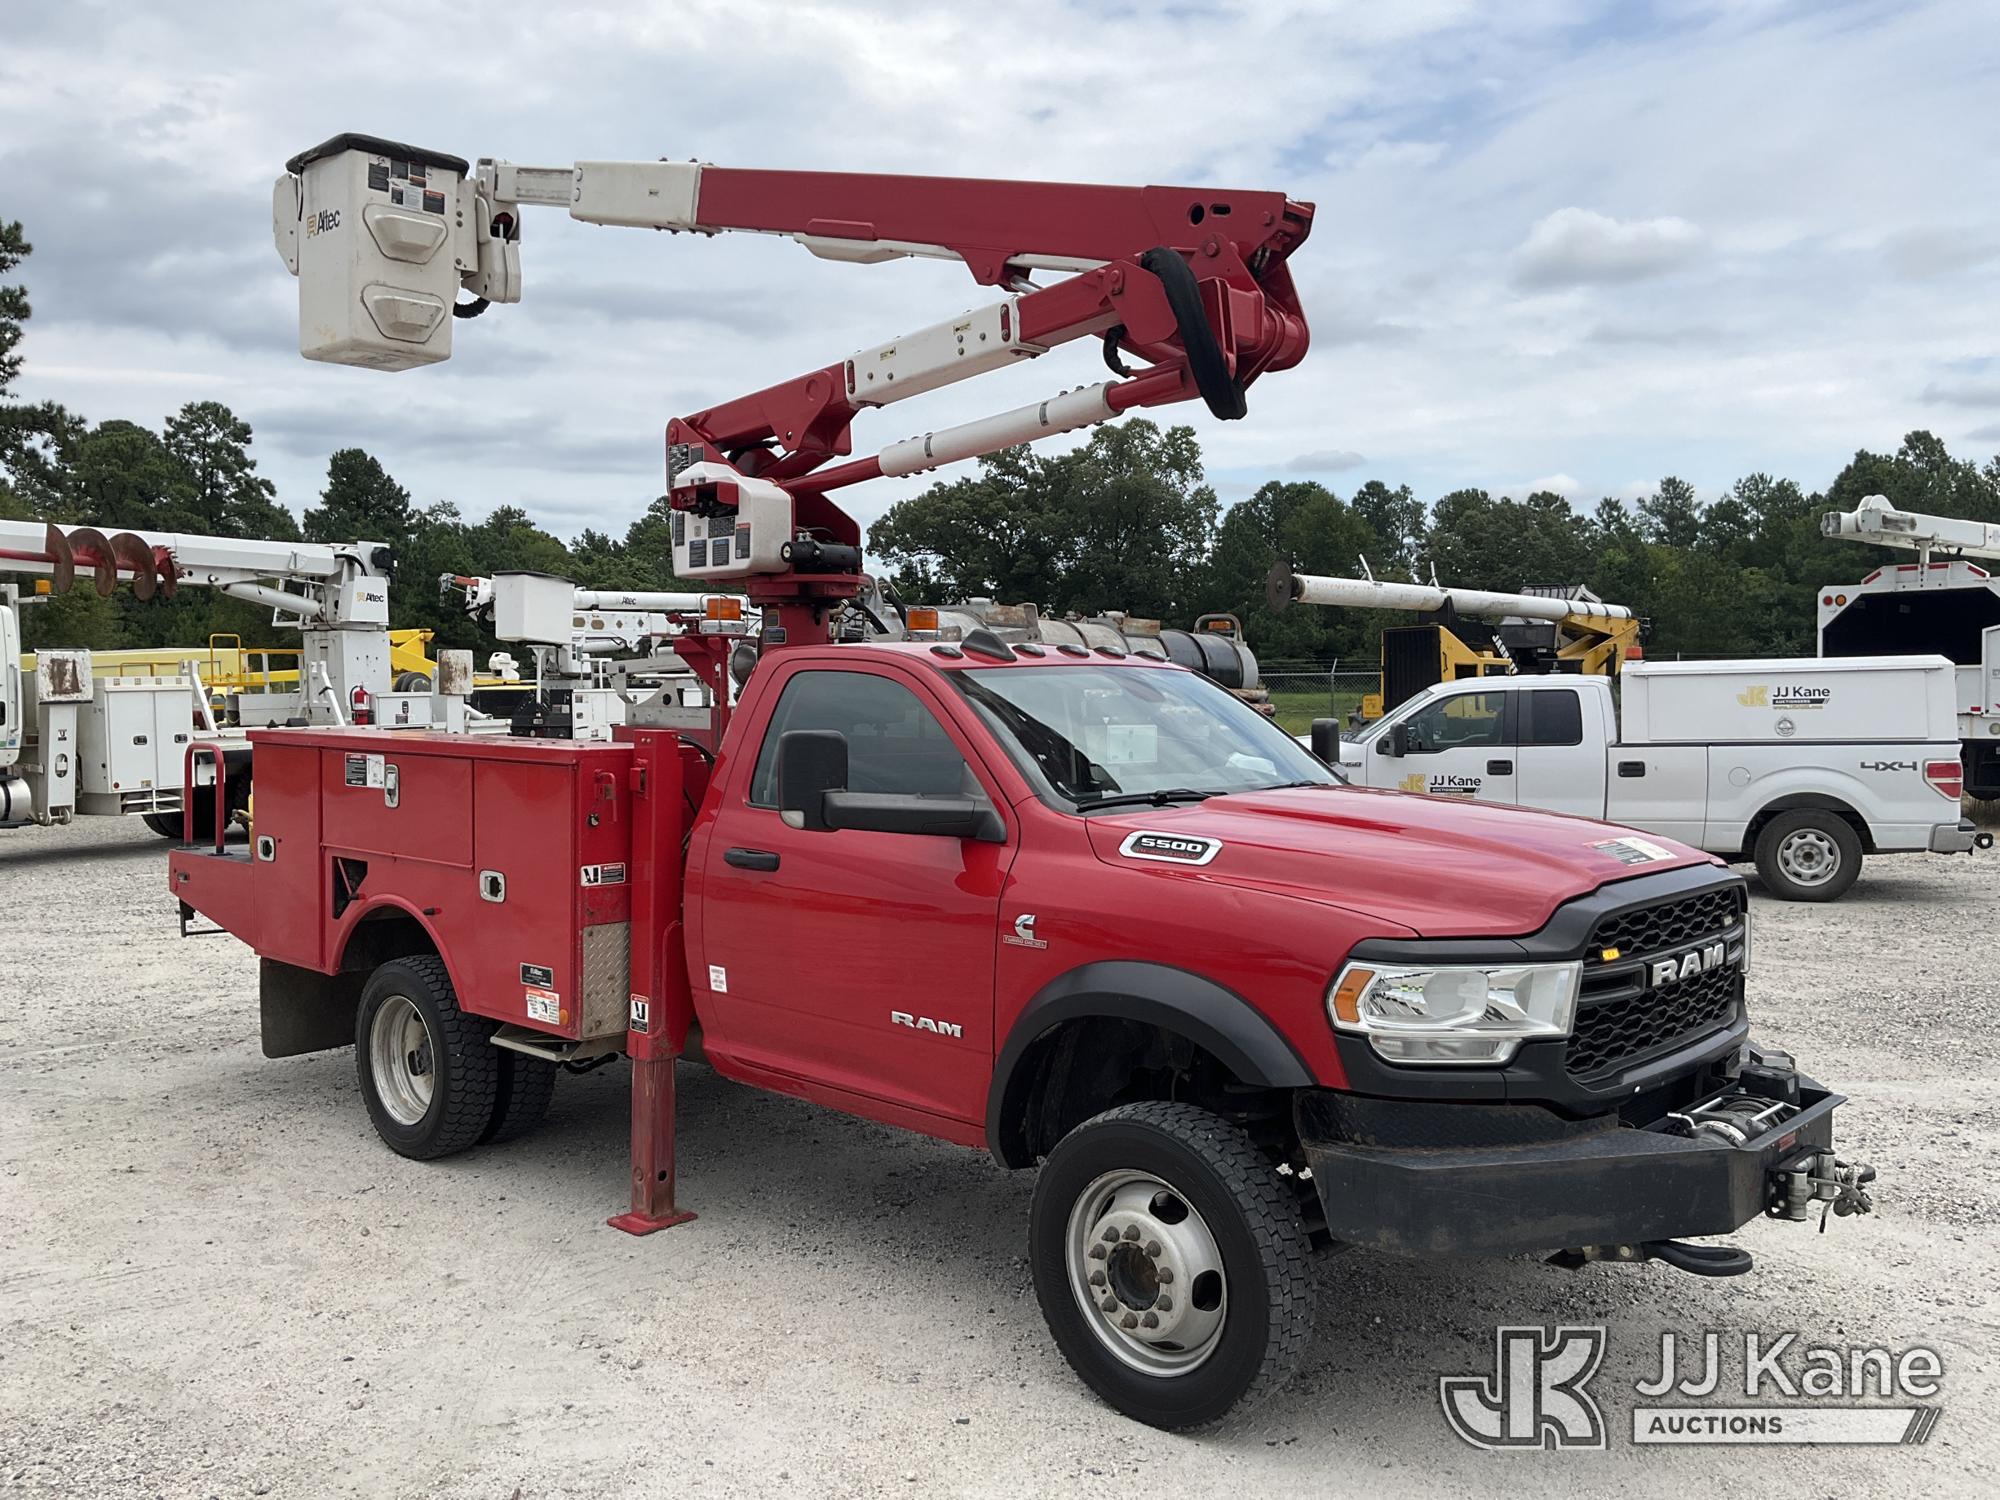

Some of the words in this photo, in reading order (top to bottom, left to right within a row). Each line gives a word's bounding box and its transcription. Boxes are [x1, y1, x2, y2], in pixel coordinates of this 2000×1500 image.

[317, 209, 341, 235] Altec
[366, 592, 384, 602] Altec
[1772, 686, 1789, 698] JJ
[1792, 686, 1831, 698] Kane
[1430, 775, 1445, 786] JJ
[1447, 775, 1481, 786] Kane
[1140, 837, 1203, 853] 5500
[1651, 942, 1724, 987] RAM
[891, 1010, 962, 1038] RAM
